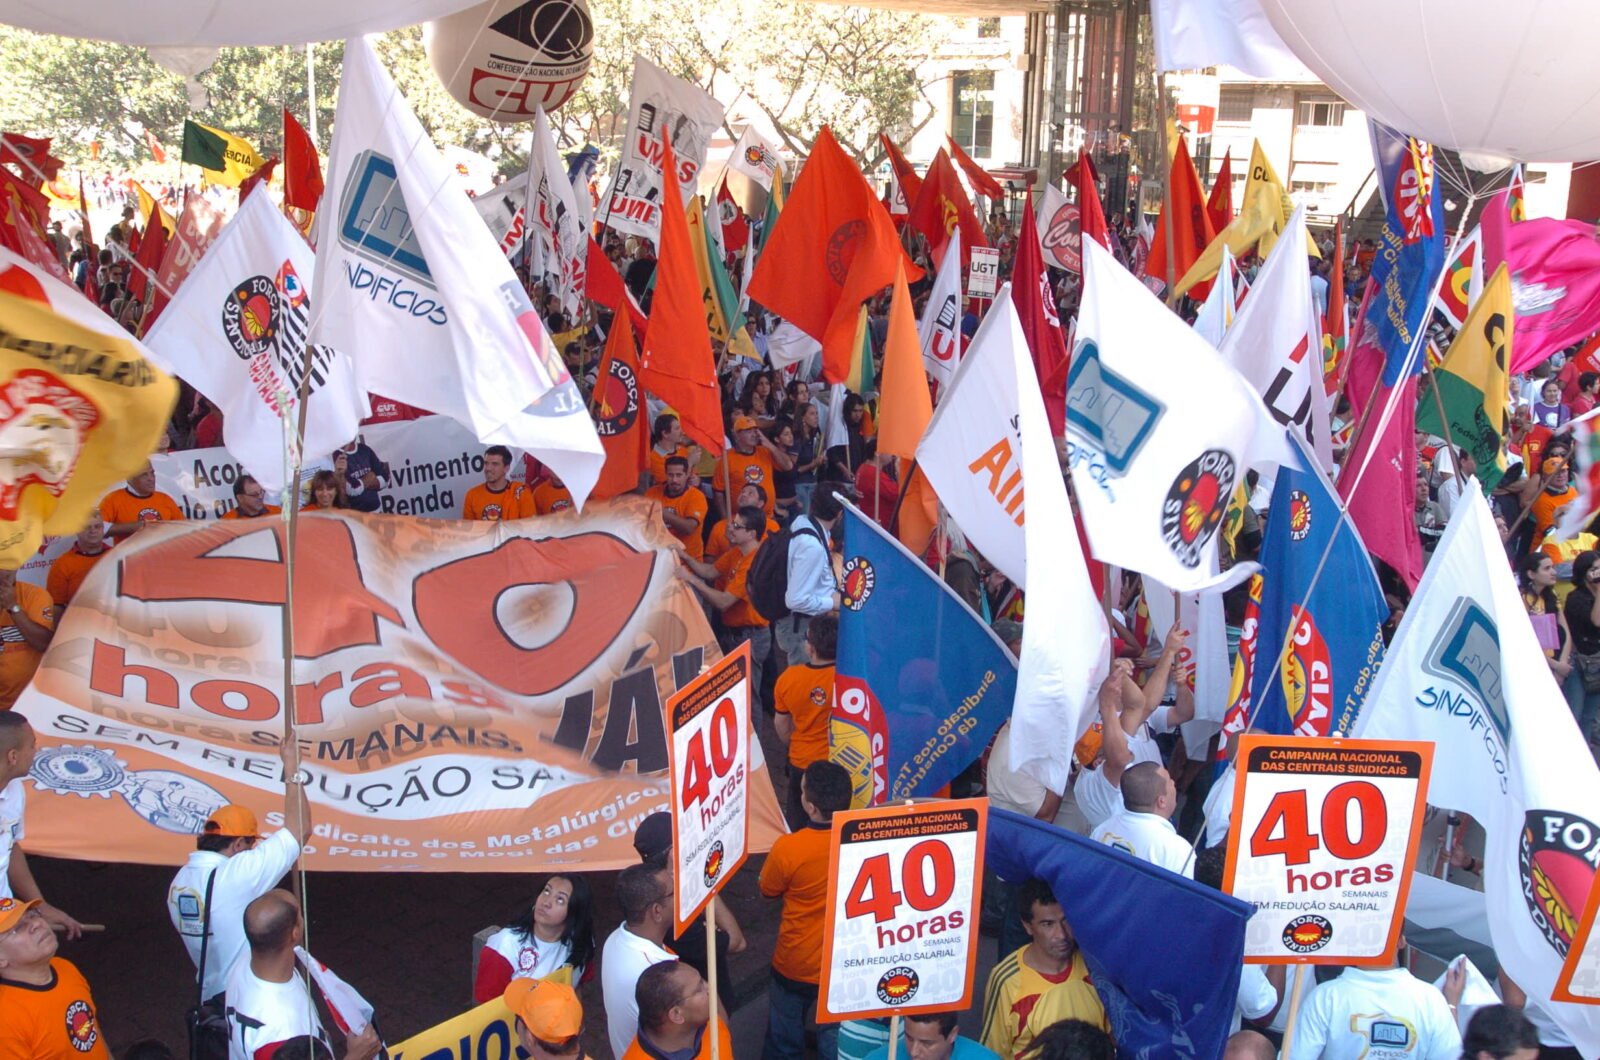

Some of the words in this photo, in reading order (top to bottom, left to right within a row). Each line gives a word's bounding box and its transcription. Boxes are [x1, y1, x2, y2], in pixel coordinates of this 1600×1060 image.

[971, 261, 997, 275] UGT
[609, 360, 638, 414] FORÇA
[388, 451, 485, 488] vimento
[115, 514, 658, 698] 40
[89, 638, 513, 726] horas
[51, 713, 181, 752] SEM
[681, 697, 739, 813] 40
[1270, 750, 1338, 762] CAMPANHA
[1339, 752, 1402, 764] NACIONAL
[1260, 761, 1286, 772] DAS
[1287, 762, 1345, 774] CENTRAIS
[1347, 763, 1408, 775] SINDICAIS
[700, 762, 745, 832] horas
[264, 811, 411, 847] Sdicato
[422, 833, 477, 850] dos
[851, 831, 872, 842] DAS
[872, 826, 920, 840] CENTRAIS
[920, 821, 969, 834] SINDICAIS
[858, 817, 913, 832] CAMPANHA
[914, 812, 964, 825] NACIONAL
[1250, 780, 1388, 867] 40
[328, 845, 418, 859] Paulo
[544, 834, 600, 856] das
[844, 838, 956, 924] 40
[1286, 863, 1395, 894] horas
[1272, 899, 1326, 912] REDUÇÃO
[1328, 901, 1380, 911] SALARIAL
[1341, 890, 1389, 899] SEMANAIS
[877, 909, 965, 950] horas
[1290, 914, 1328, 928] FORÇA
[922, 935, 962, 948] SEMANAIS
[1282, 934, 1331, 954] SINDICAL
[843, 958, 866, 969] SEM
[866, 952, 912, 967] REDUÇÃO
[913, 948, 956, 961] SALARIAL
[883, 966, 915, 981] FORÇA
[877, 985, 919, 1006] SINDICAL
